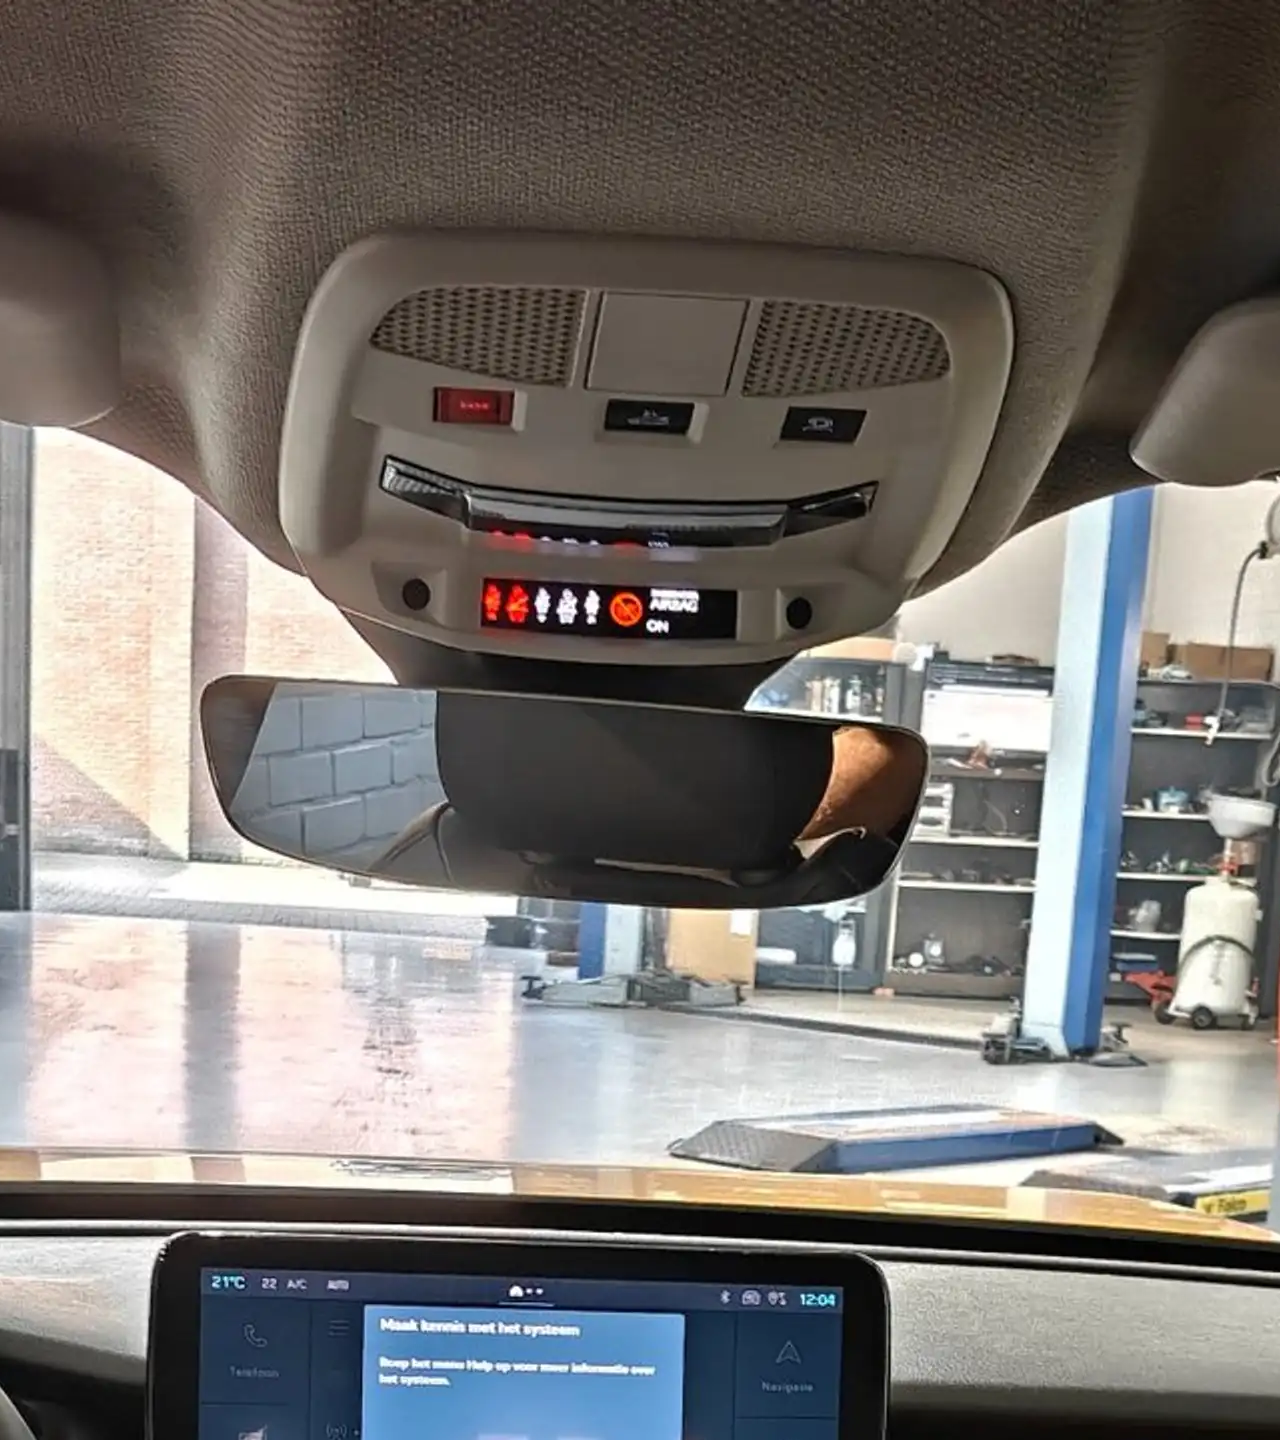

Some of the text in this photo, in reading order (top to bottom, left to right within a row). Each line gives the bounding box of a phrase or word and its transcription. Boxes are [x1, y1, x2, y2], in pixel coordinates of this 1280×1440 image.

[649, 599, 699, 613] AIRBAG
[646, 619, 670, 633] ON
[211, 1276, 246, 1290] 21°C
[261, 1278, 278, 1290] 22
[286, 1279, 308, 1290] A/C
[800, 1293, 836, 1307] 12:04
[380, 1318, 581, 1339] Maak kennis met het systeem
